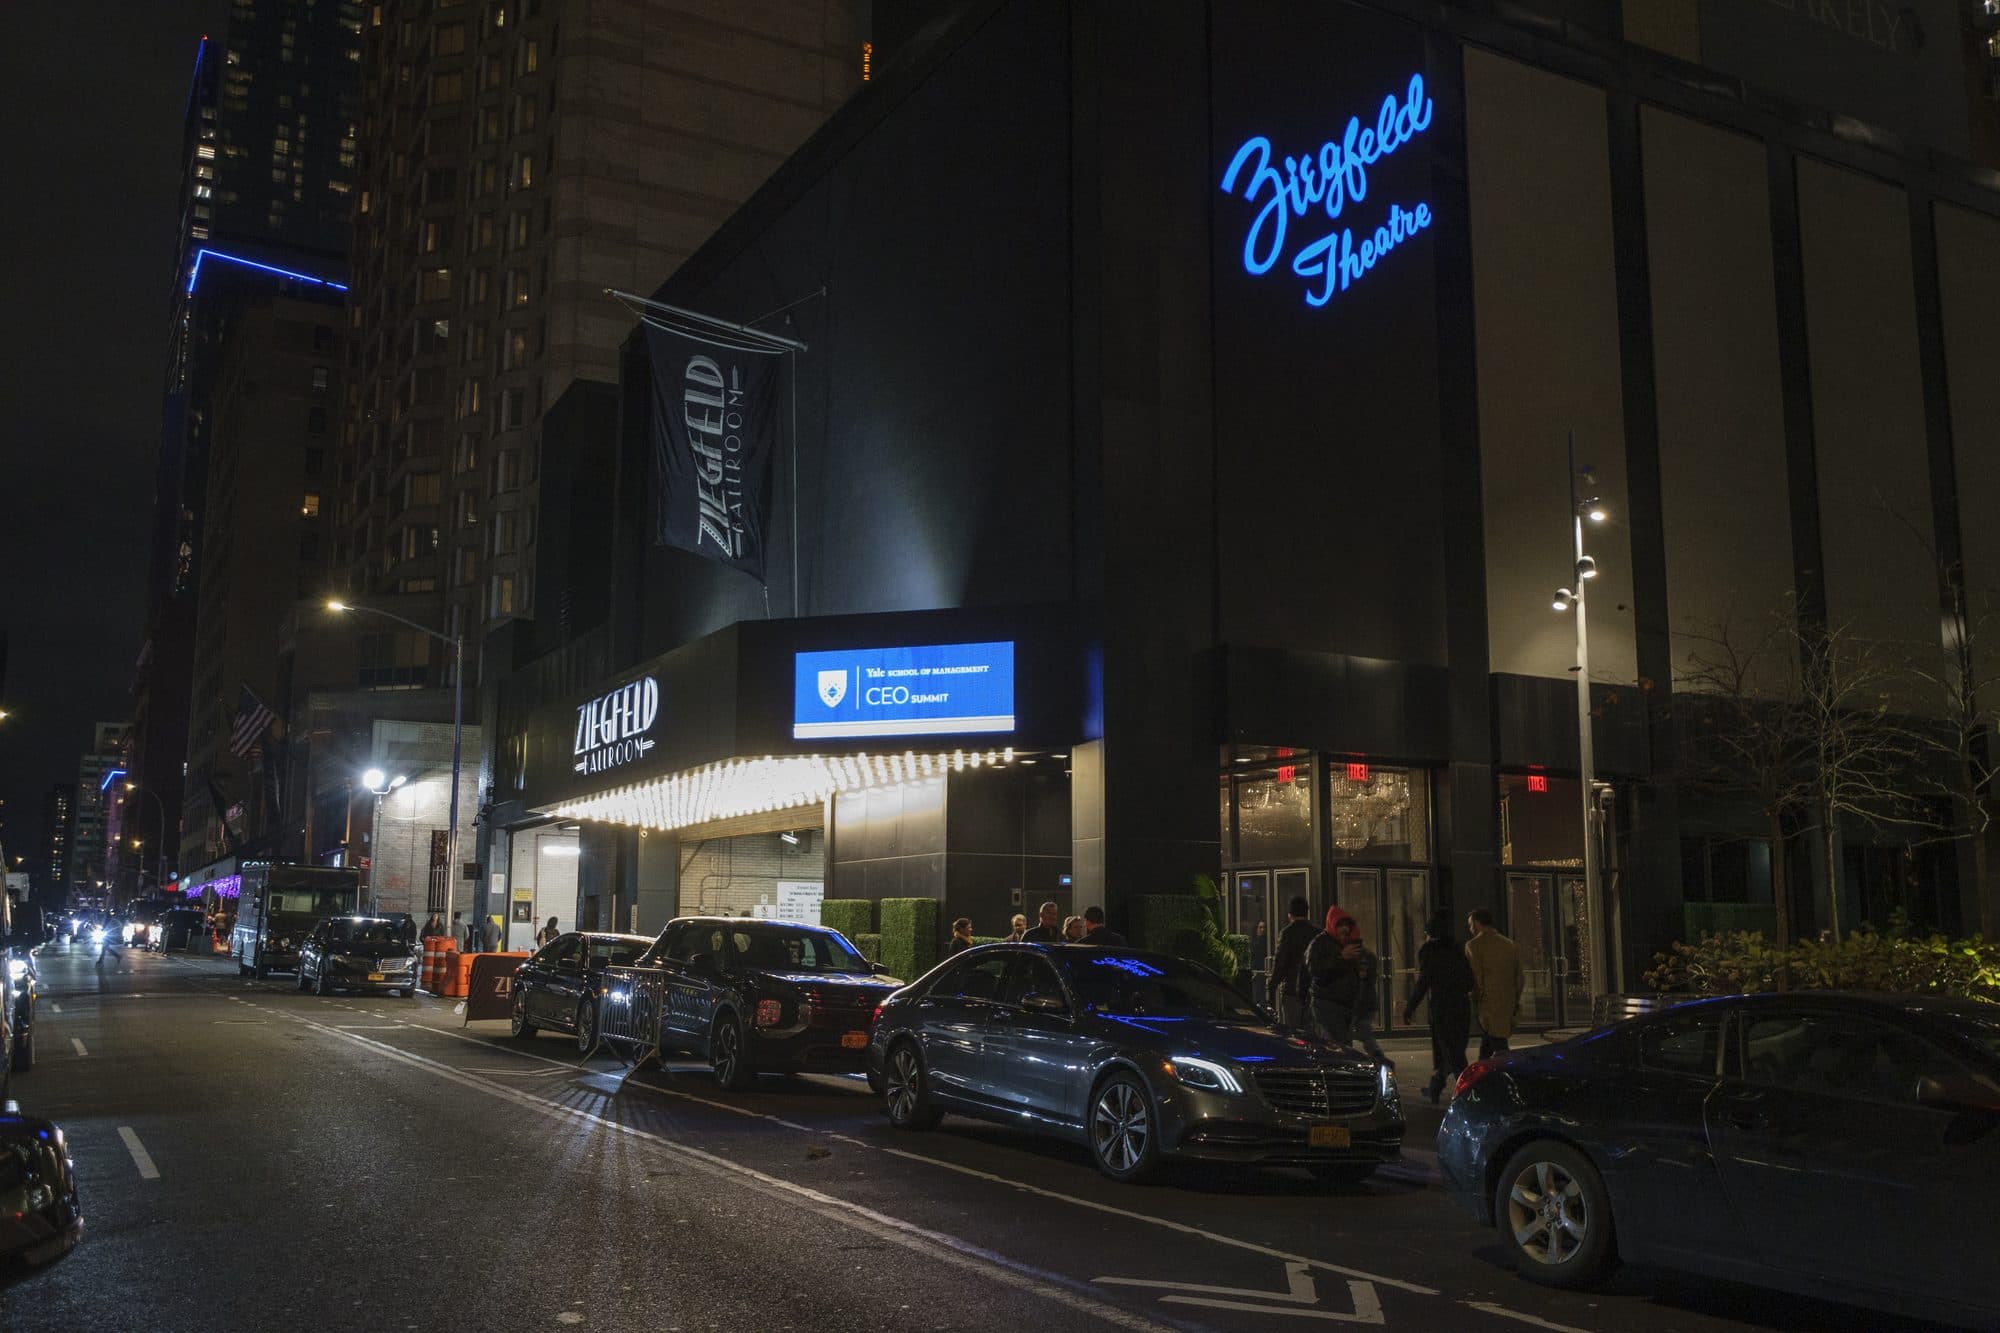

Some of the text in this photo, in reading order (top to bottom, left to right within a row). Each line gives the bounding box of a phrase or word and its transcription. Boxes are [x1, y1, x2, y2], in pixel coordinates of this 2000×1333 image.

[1221, 73, 1433, 275] Ziegfeld
[1293, 203, 1432, 307] Theatre
[684, 355, 732, 557] ZIEGFELD
[575, 677, 659, 755] ZIEGFELD
[866, 665, 989, 677] Yale SCHOOL OF MANAGEMENT
[866, 686, 949, 705] CEO SUMMIT
